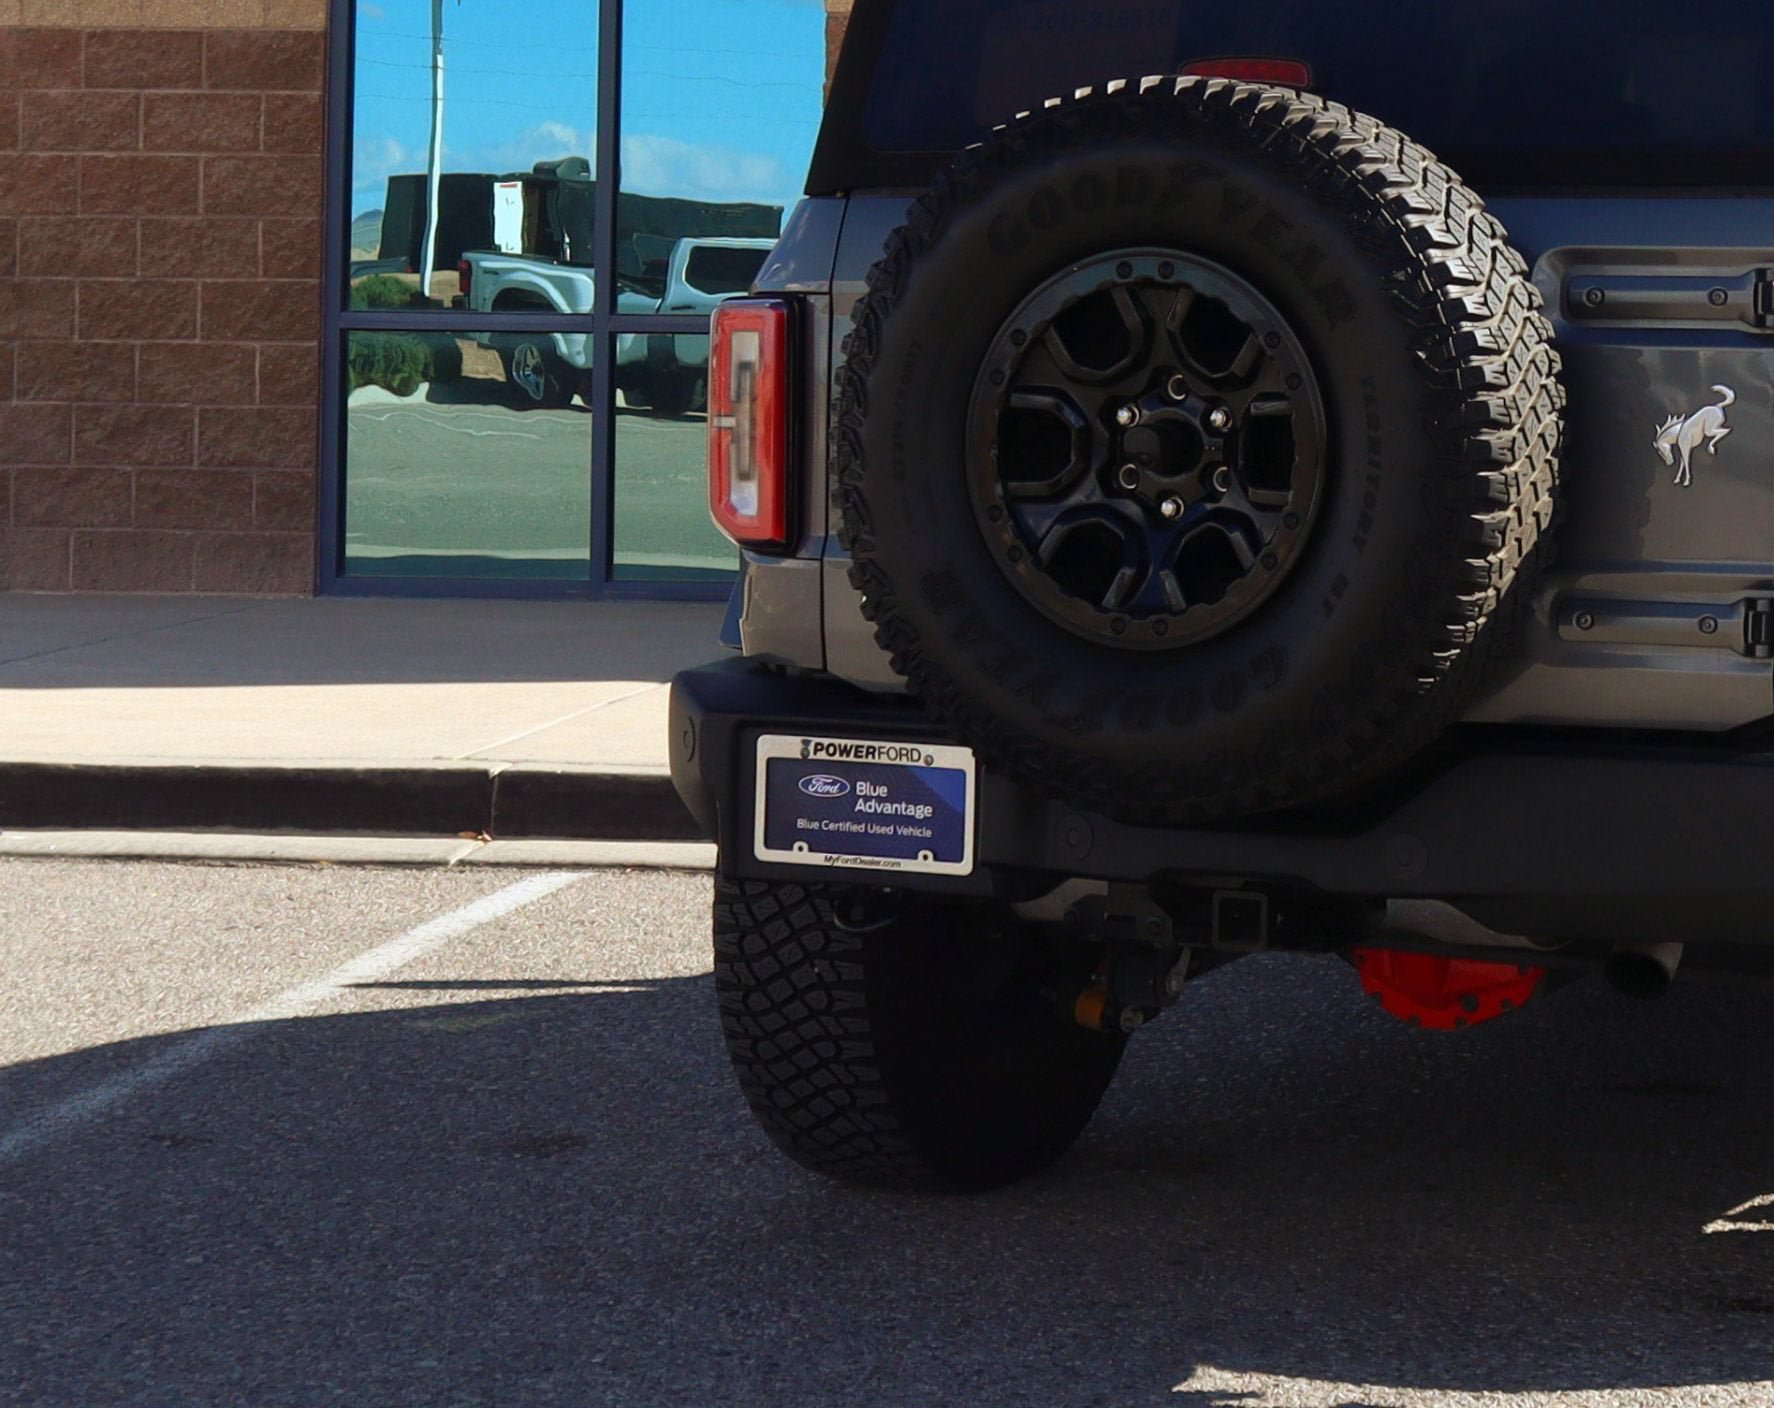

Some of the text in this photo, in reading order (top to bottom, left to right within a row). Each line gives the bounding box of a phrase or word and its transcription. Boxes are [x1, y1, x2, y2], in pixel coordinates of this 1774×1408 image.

[812, 741, 922, 763] POWERFORD
[807, 776, 841, 794] Ford
[855, 780, 888, 798] Blue
[854, 798, 933, 819] Advantage
[796, 817, 933, 838] Blue Certified Used Vehicle
